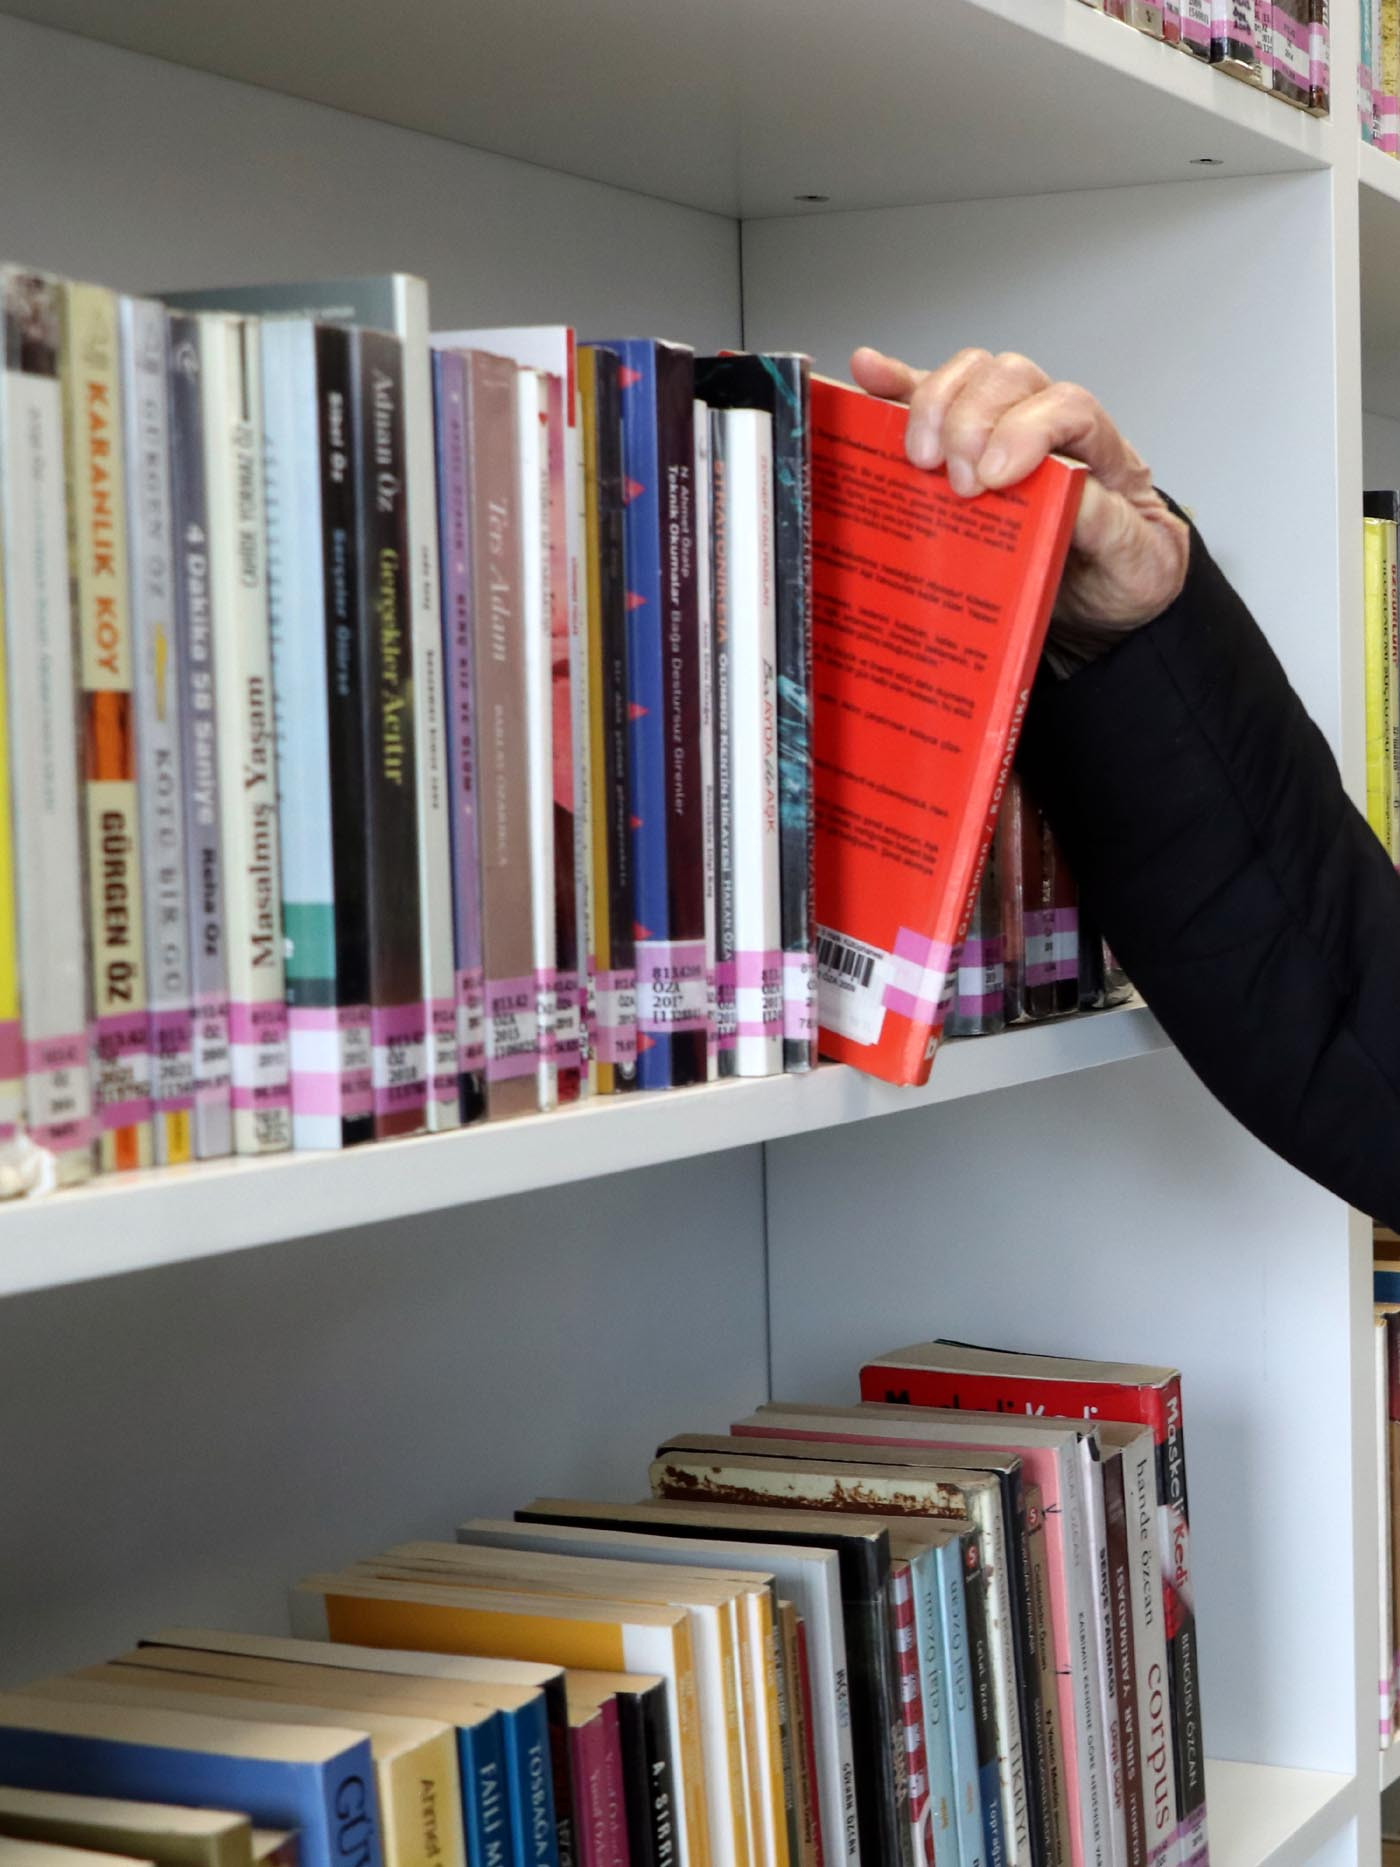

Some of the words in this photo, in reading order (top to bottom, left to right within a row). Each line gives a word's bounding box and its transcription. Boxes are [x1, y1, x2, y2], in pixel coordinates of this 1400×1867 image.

[372, 368, 394, 466] Adnan
[85, 381, 116, 577] KARANLIK
[377, 475, 401, 513] Öz
[667, 463, 680, 521] Teknik
[680, 485, 689, 533] Ahmet
[186, 523, 205, 543] 4
[668, 523, 681, 605] Okumalar
[680, 536, 692, 577] Özalp
[188, 553, 212, 661] Dakika
[379, 547, 403, 687] Gerçekler
[489, 563, 509, 662] Adam
[669, 610, 683, 652] Bağa
[193, 671, 213, 711] 58
[671, 657, 684, 742] Destursuz
[245, 675, 273, 790] Yaşam
[382, 689, 407, 785] Acıtır
[760, 699, 777, 756] AYDA
[195, 719, 217, 826] Saniye
[673, 747, 685, 817] Girenler
[719, 732, 732, 799] KENTİN
[720, 800, 733, 872] HİKAYESİ
[762, 789, 778, 833] AŞK
[100, 810, 130, 947] GÜRGEN
[199, 847, 219, 914] Reha
[249, 801, 276, 970] Masalmış
[722, 877, 734, 927] HAKAN
[107, 957, 138, 1005] ÖZ
[1164, 1396, 1184, 1517] Maskeli
[1097, 1546, 1110, 1609] SERÇE
[1136, 1457, 1150, 1541] hande
[1143, 1549, 1156, 1629] özcan
[1172, 1520, 1190, 1590] Kedi
[975, 1639, 987, 1677] Celal
[1076, 1610, 1089, 1671] KALBİMİN
[1103, 1613, 1116, 1699] PARMAĞI
[1113, 1564, 1133, 1697] YARIMADASI
[926, 1668, 942, 1725] Celal
[951, 1656, 966, 1712] Celal
[978, 1682, 990, 1721] Özcan
[1081, 1674, 1093, 1730] KENDİNE
[1180, 1633, 1191, 1719] BENGÜSU
[651, 1760, 667, 1786] A.
[1086, 1734, 1097, 1770] GÖRE
[1122, 1705, 1137, 1781] SIRLAR
[1146, 1664, 1172, 1829] corpus
[1184, 1725, 1197, 1788] ÖZCAN
[478, 1762, 503, 1833] FAİLİ
[1009, 1741, 1028, 1851] FİKRİYE
[1088, 1774, 1102, 1842] NEDENLERİ
